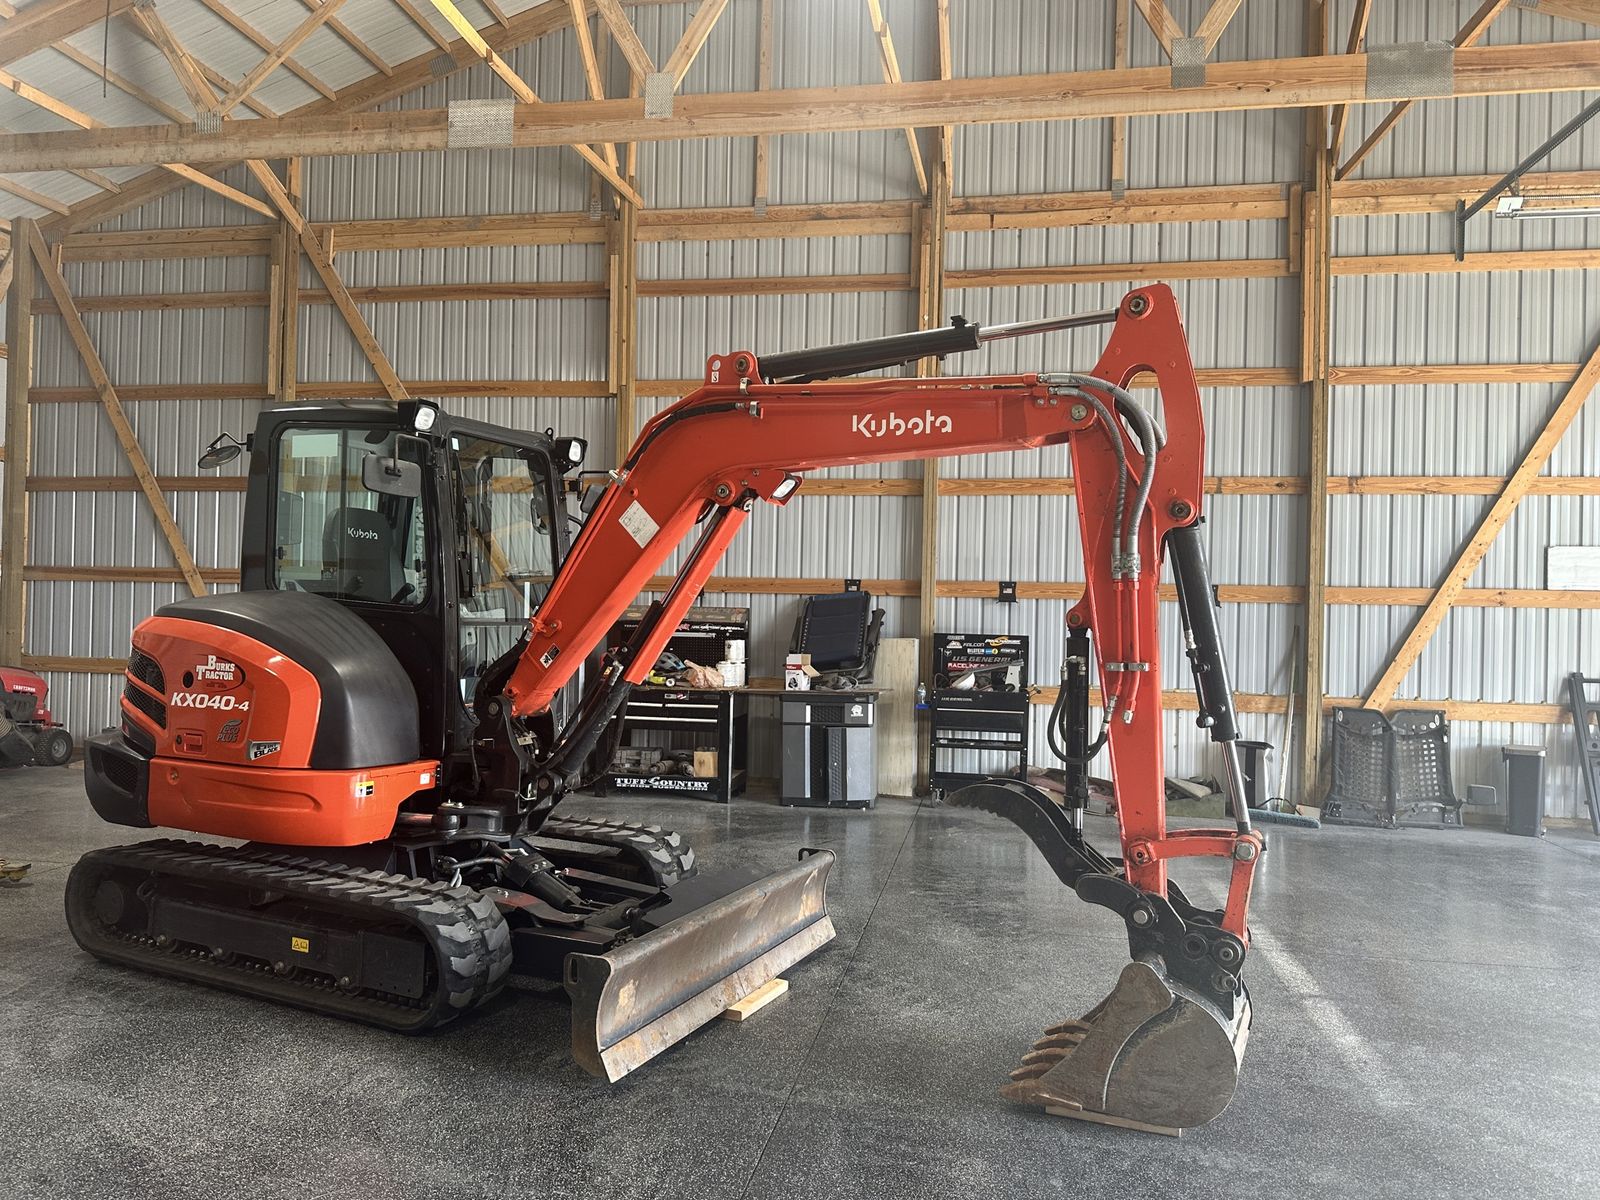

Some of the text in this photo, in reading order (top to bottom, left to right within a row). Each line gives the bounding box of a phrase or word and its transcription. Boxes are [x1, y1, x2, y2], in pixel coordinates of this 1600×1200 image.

[851, 409, 953, 438] Kubota
[347, 527, 379, 540] Kubota
[171, 692, 249, 711] KX040-4
[615, 776, 710, 788] TUFF COUNTRY
